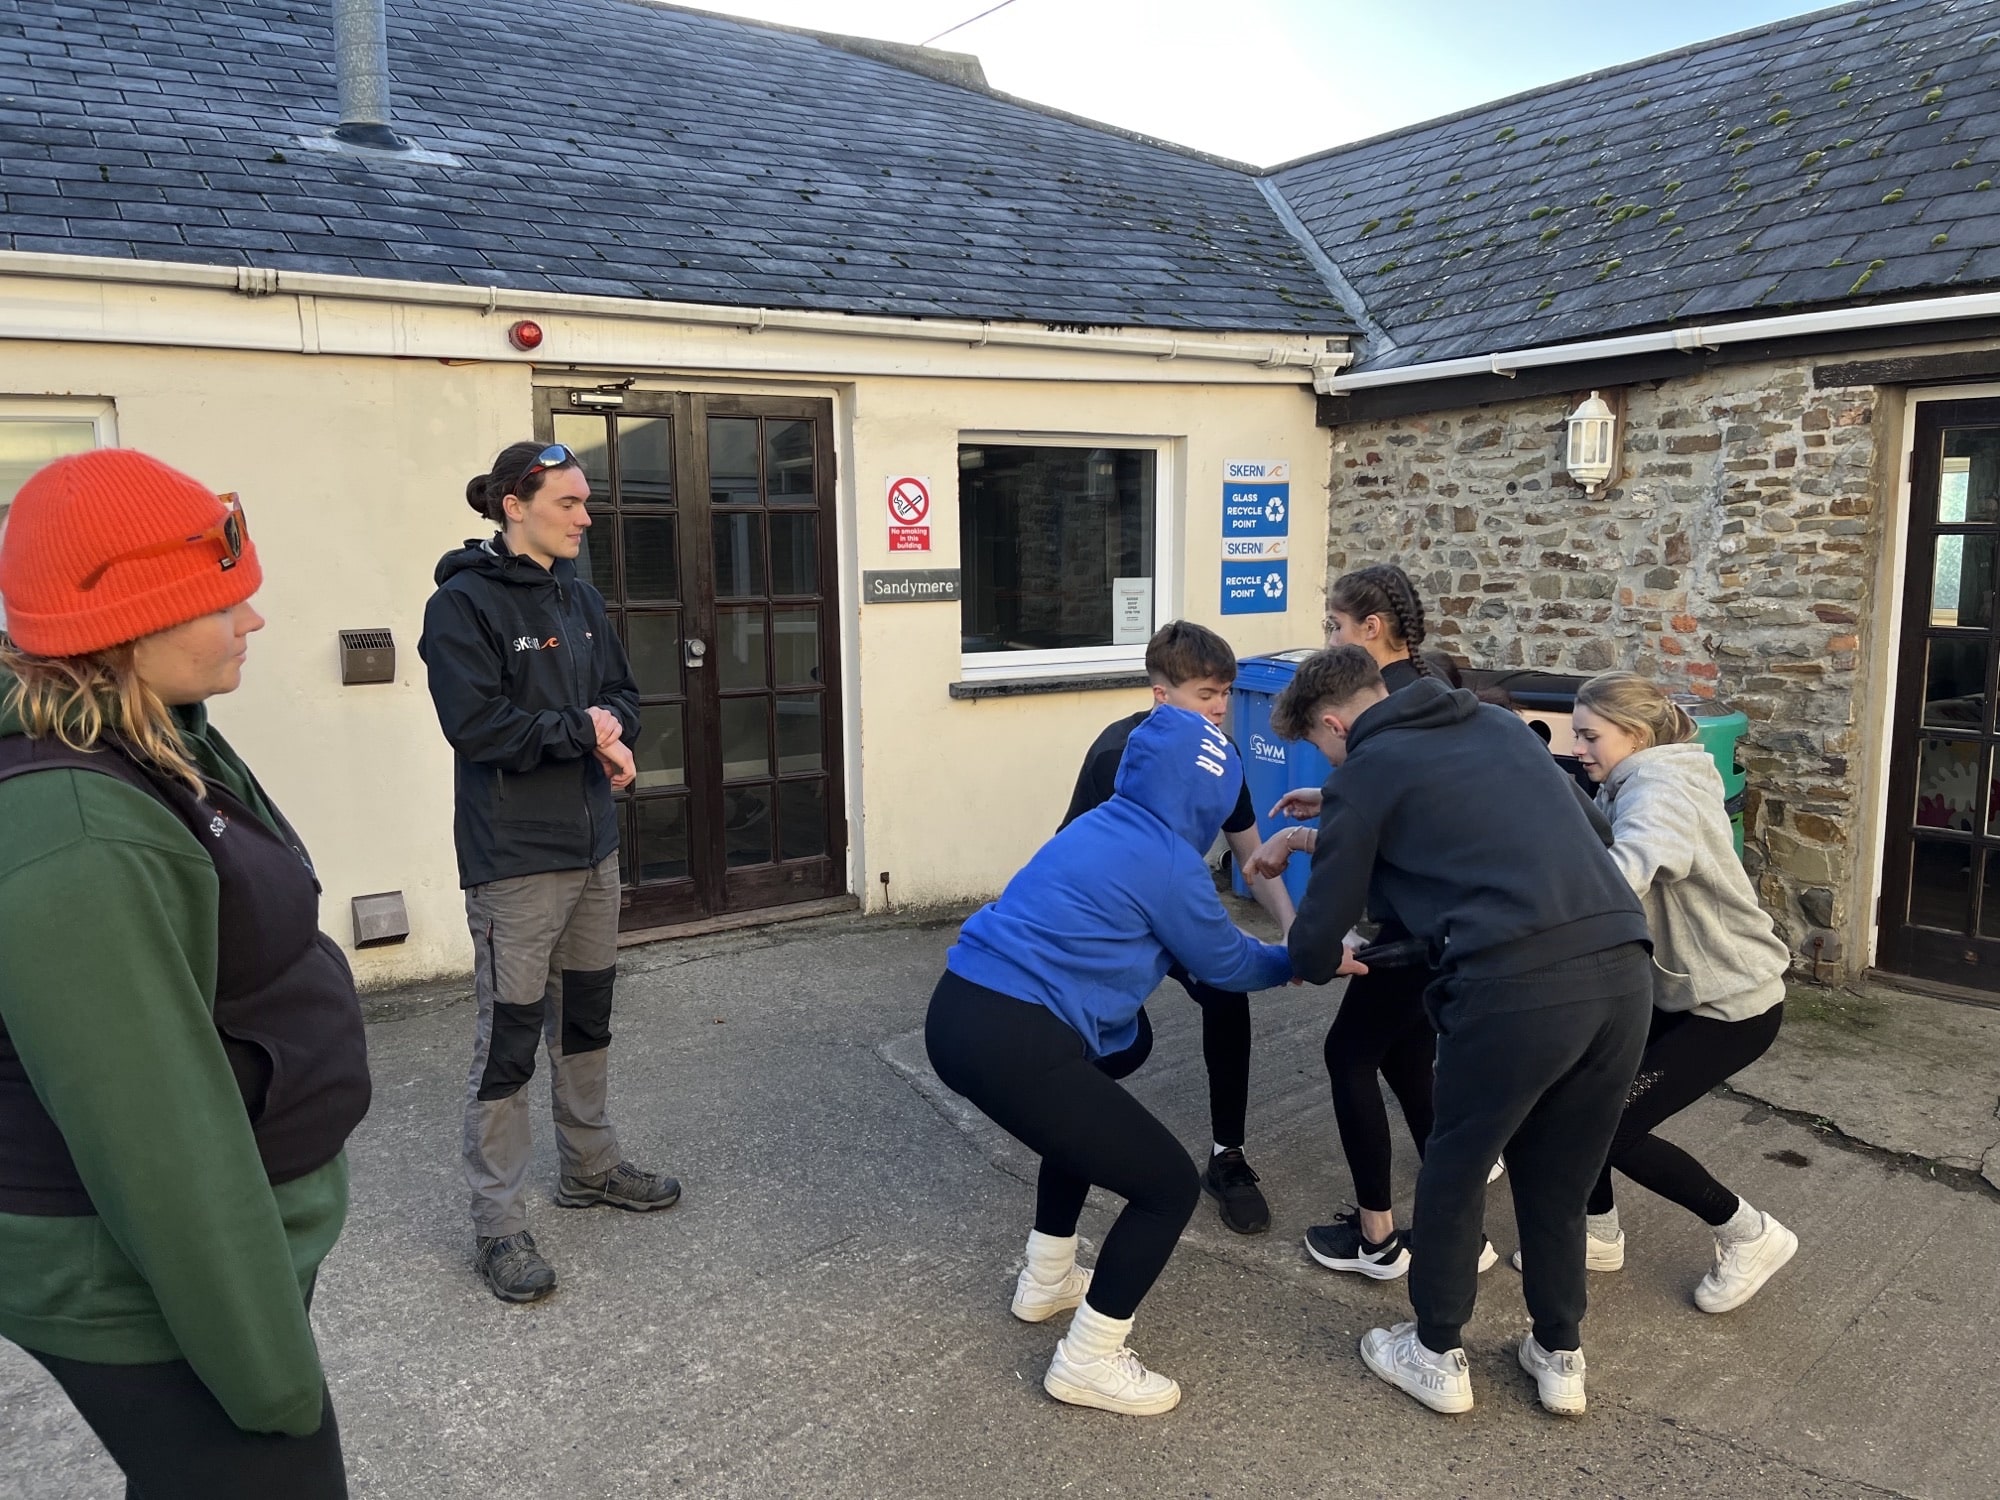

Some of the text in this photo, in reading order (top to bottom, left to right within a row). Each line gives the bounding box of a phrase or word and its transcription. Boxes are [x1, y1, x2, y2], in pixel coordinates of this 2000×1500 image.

[1229, 464, 1263, 477] SKERN
[1232, 493, 1258, 502] GLASS
[1226, 506, 1263, 515] RECYCLE
[1232, 519, 1257, 528] POINT
[901, 528, 928, 537] smoking
[899, 534, 919, 542] in this
[896, 542, 922, 550] building
[1227, 542, 1262, 555] SKERN
[1225, 576, 1262, 586] RECYCLE
[874, 578, 954, 597] Sandymere
[1230, 589, 1256, 599] POINT
[1255, 741, 1286, 760] SWM
[1420, 1373, 1446, 1390] AIR
